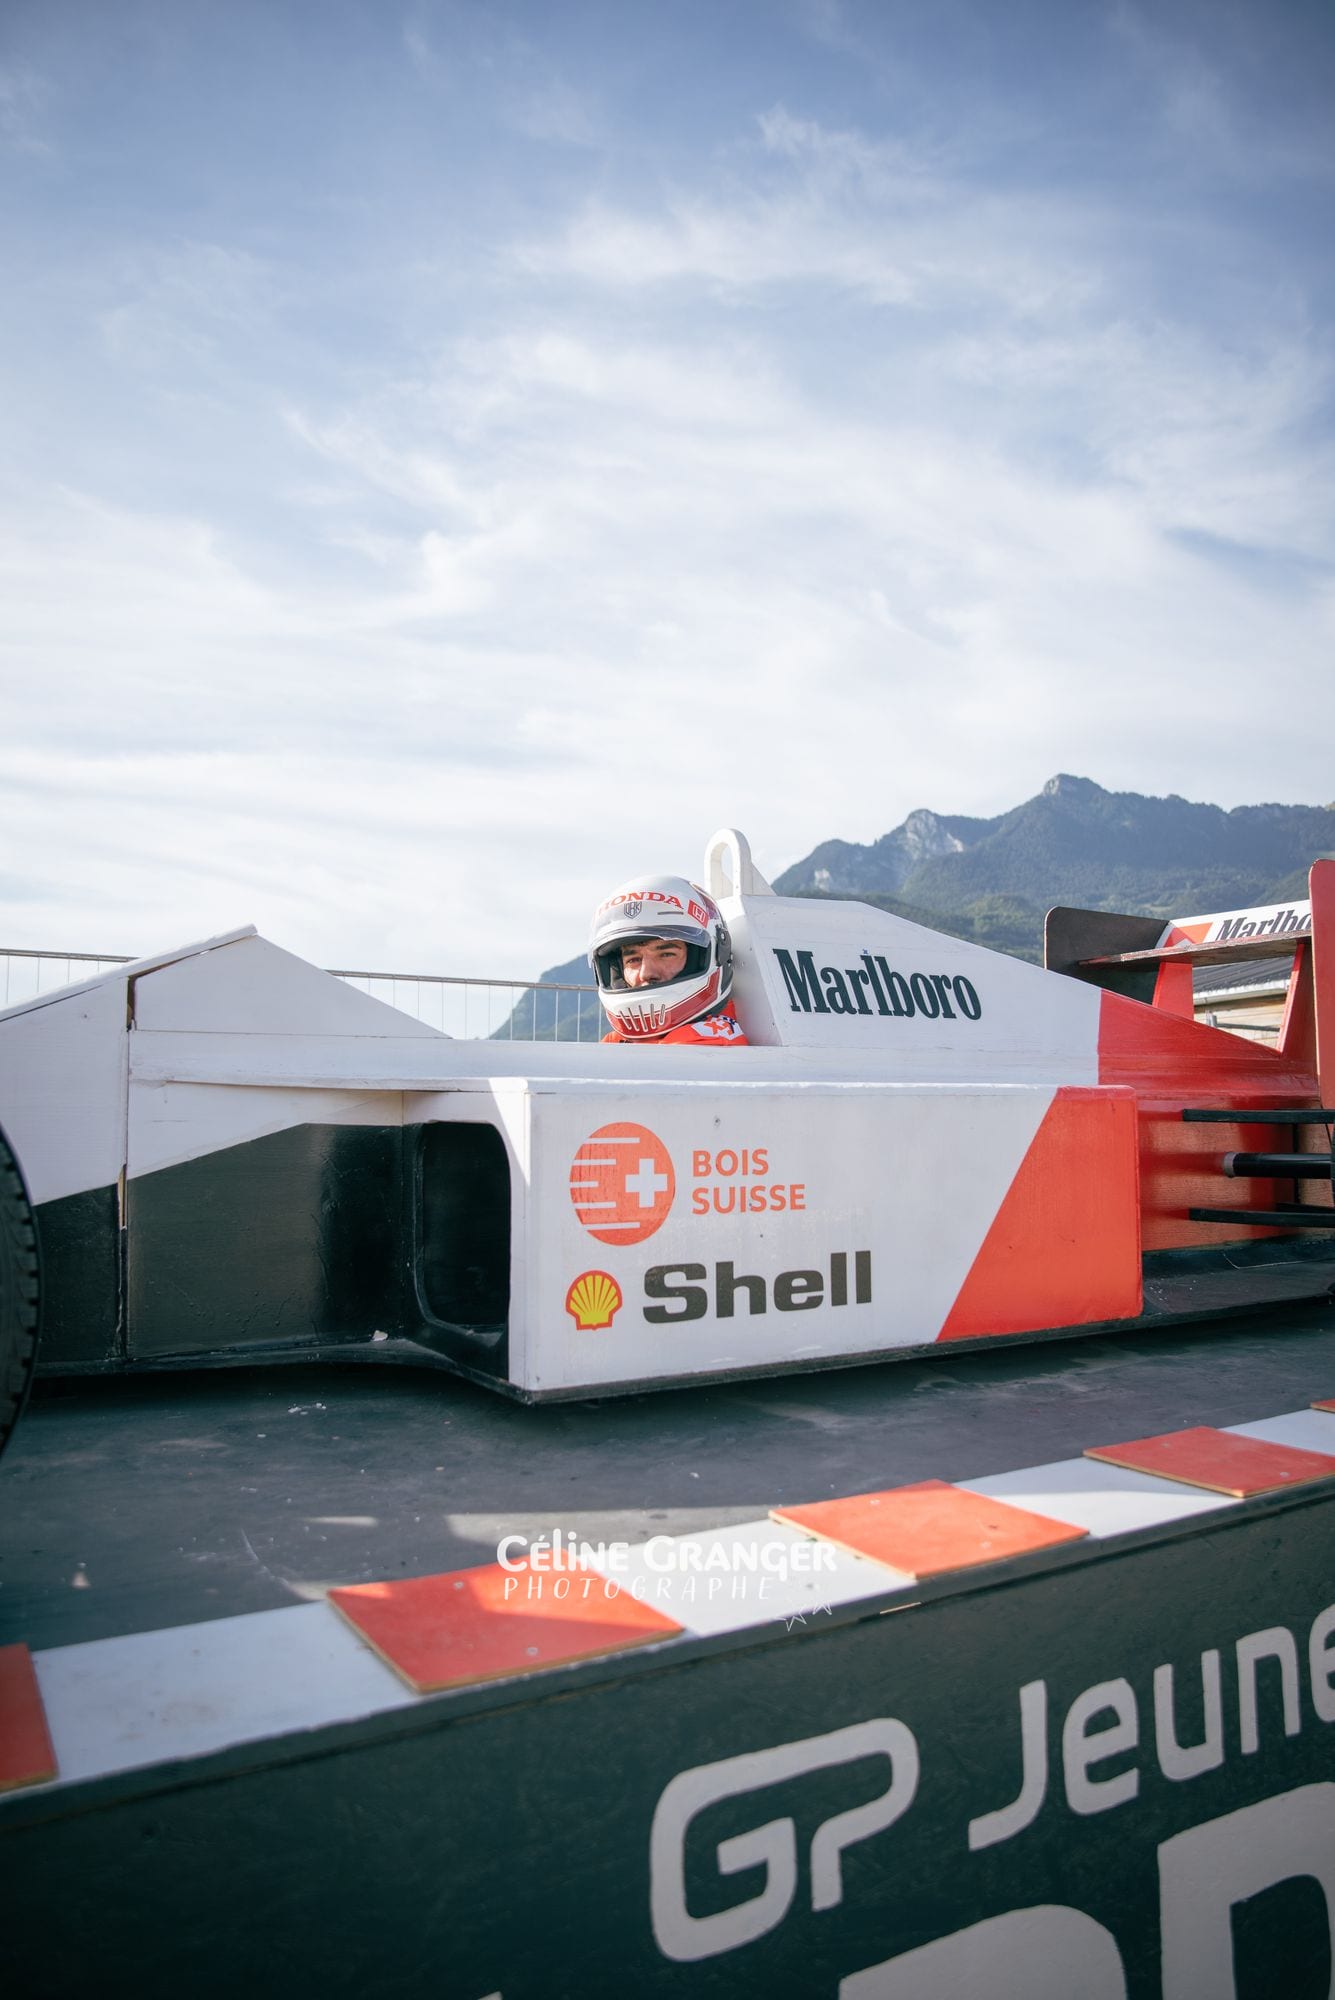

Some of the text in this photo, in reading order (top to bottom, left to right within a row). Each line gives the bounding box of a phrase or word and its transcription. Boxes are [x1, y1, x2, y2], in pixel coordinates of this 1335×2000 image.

[772, 948, 982, 1021] Marlboro
[692, 1148, 769, 1178] BOIS
[692, 1184, 806, 1215] SUISSE
[642, 1250, 872, 1324] Shell
[649, 1717, 920, 1962] GP
